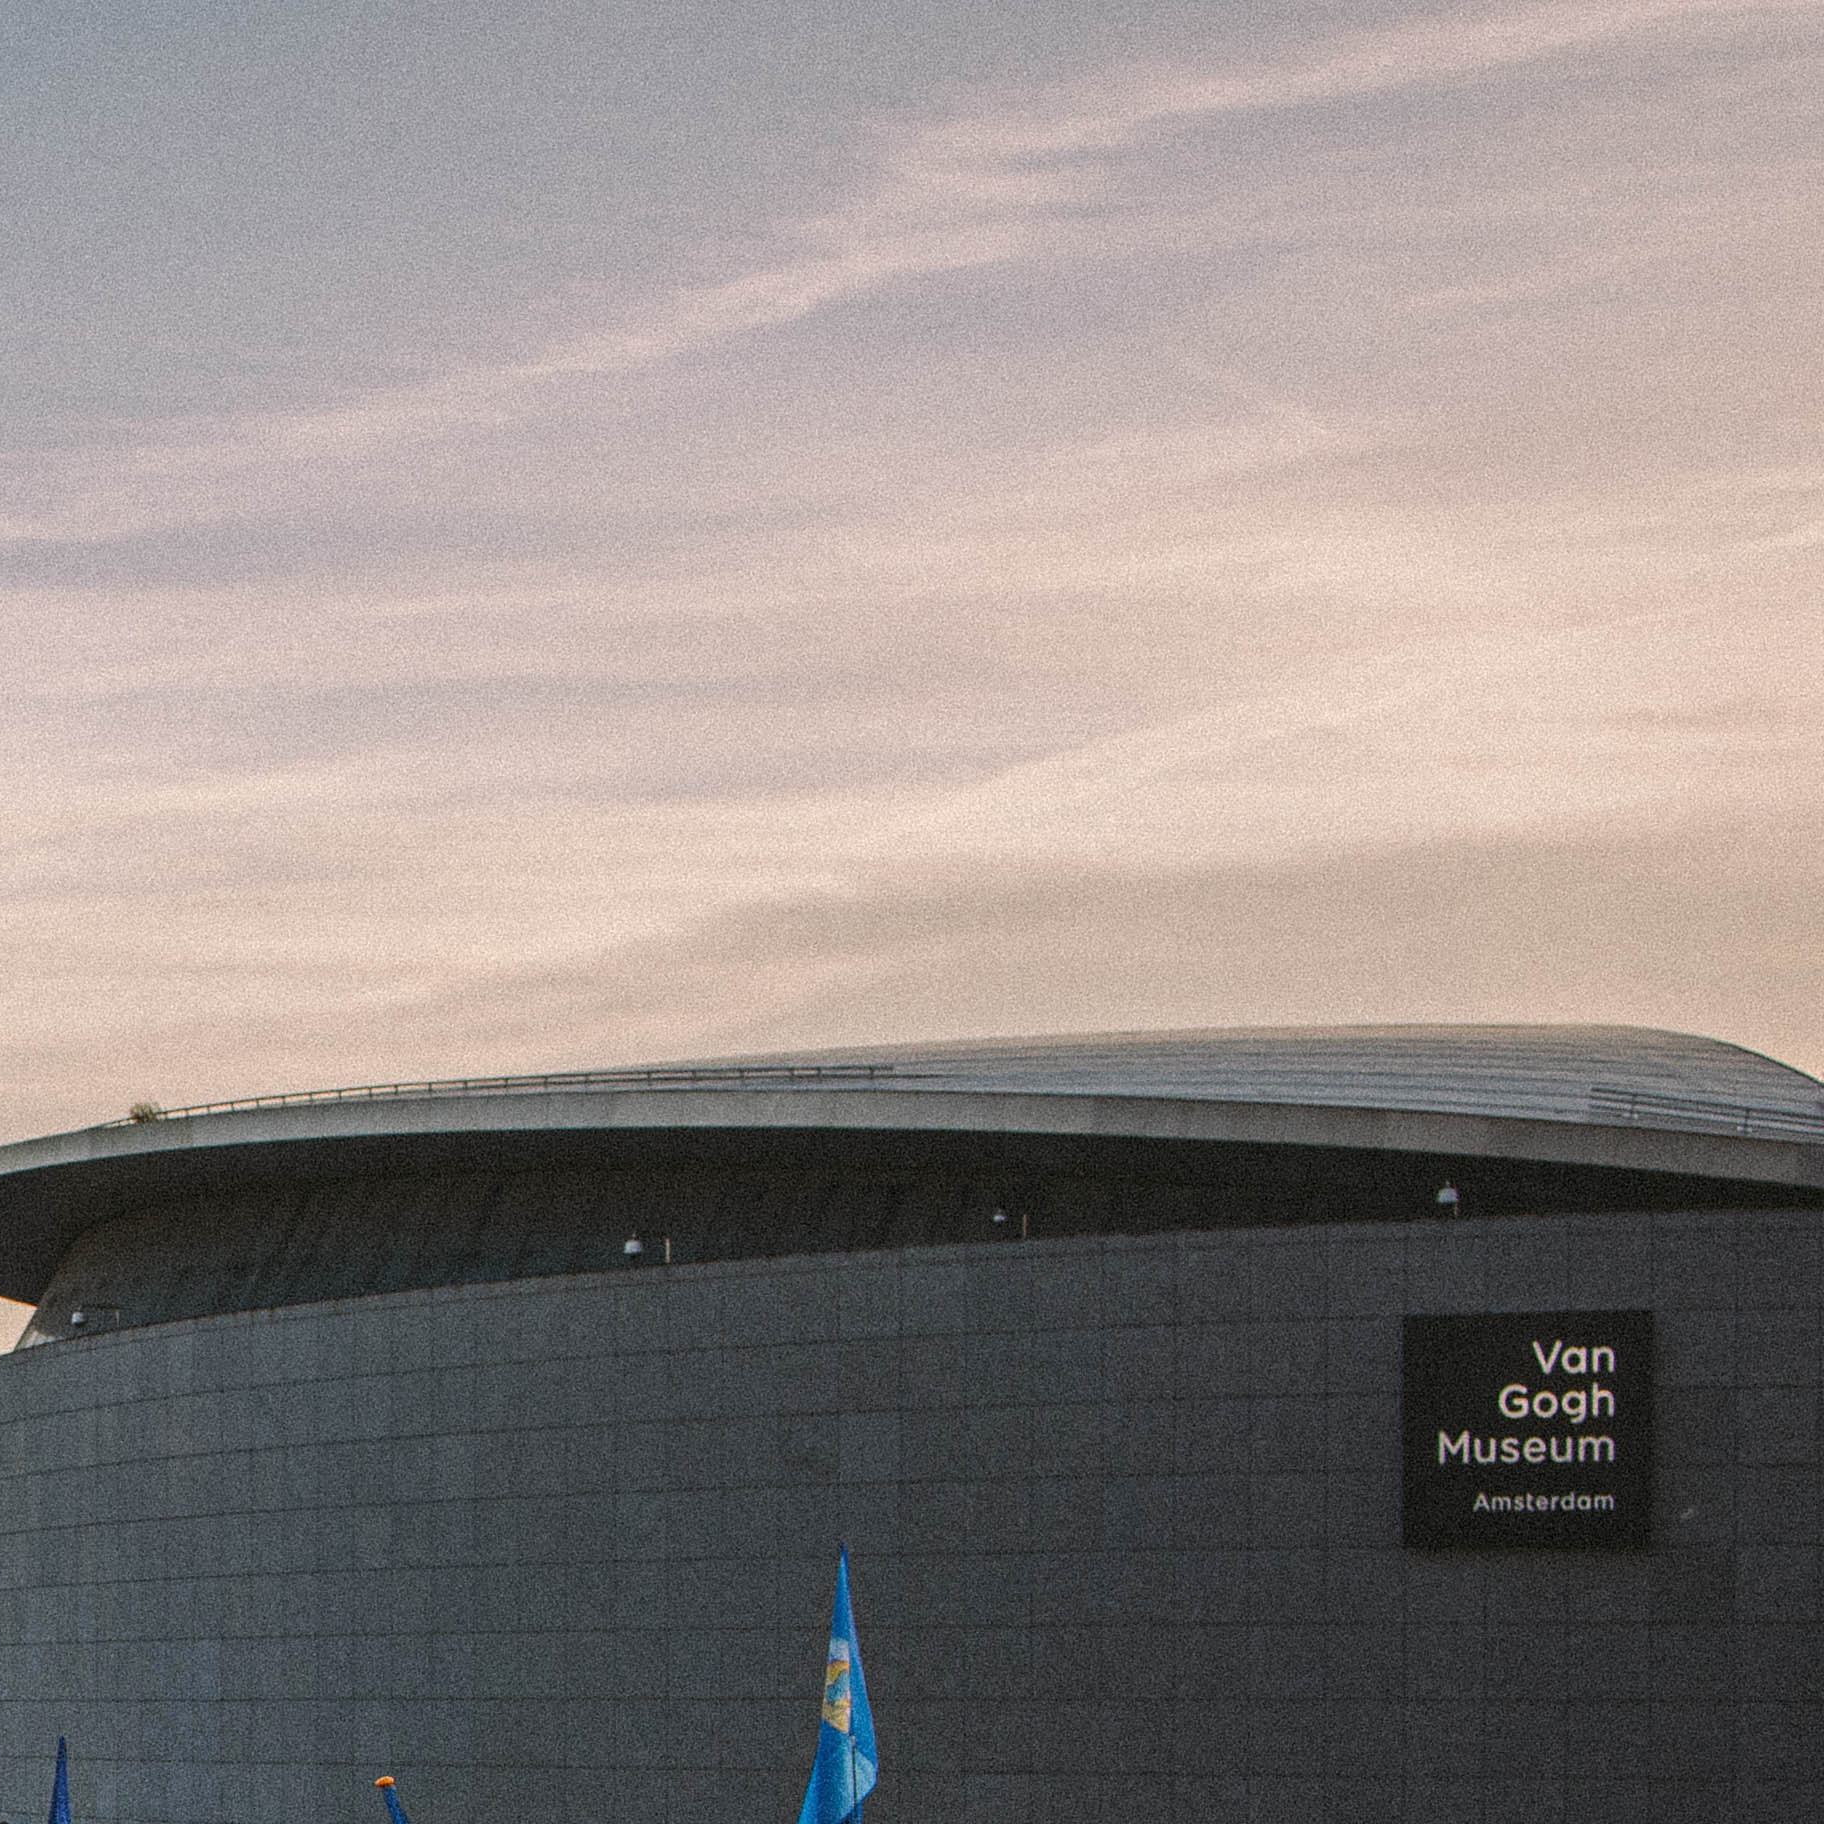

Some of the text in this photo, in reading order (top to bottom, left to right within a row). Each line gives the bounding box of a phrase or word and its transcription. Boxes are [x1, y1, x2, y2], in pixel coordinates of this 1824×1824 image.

[1531, 1339, 1617, 1375] Van
[1497, 1381, 1617, 1425] Gogh
[1437, 1429, 1617, 1465] Museum
[1472, 1491, 1616, 1513] Amsterdam
